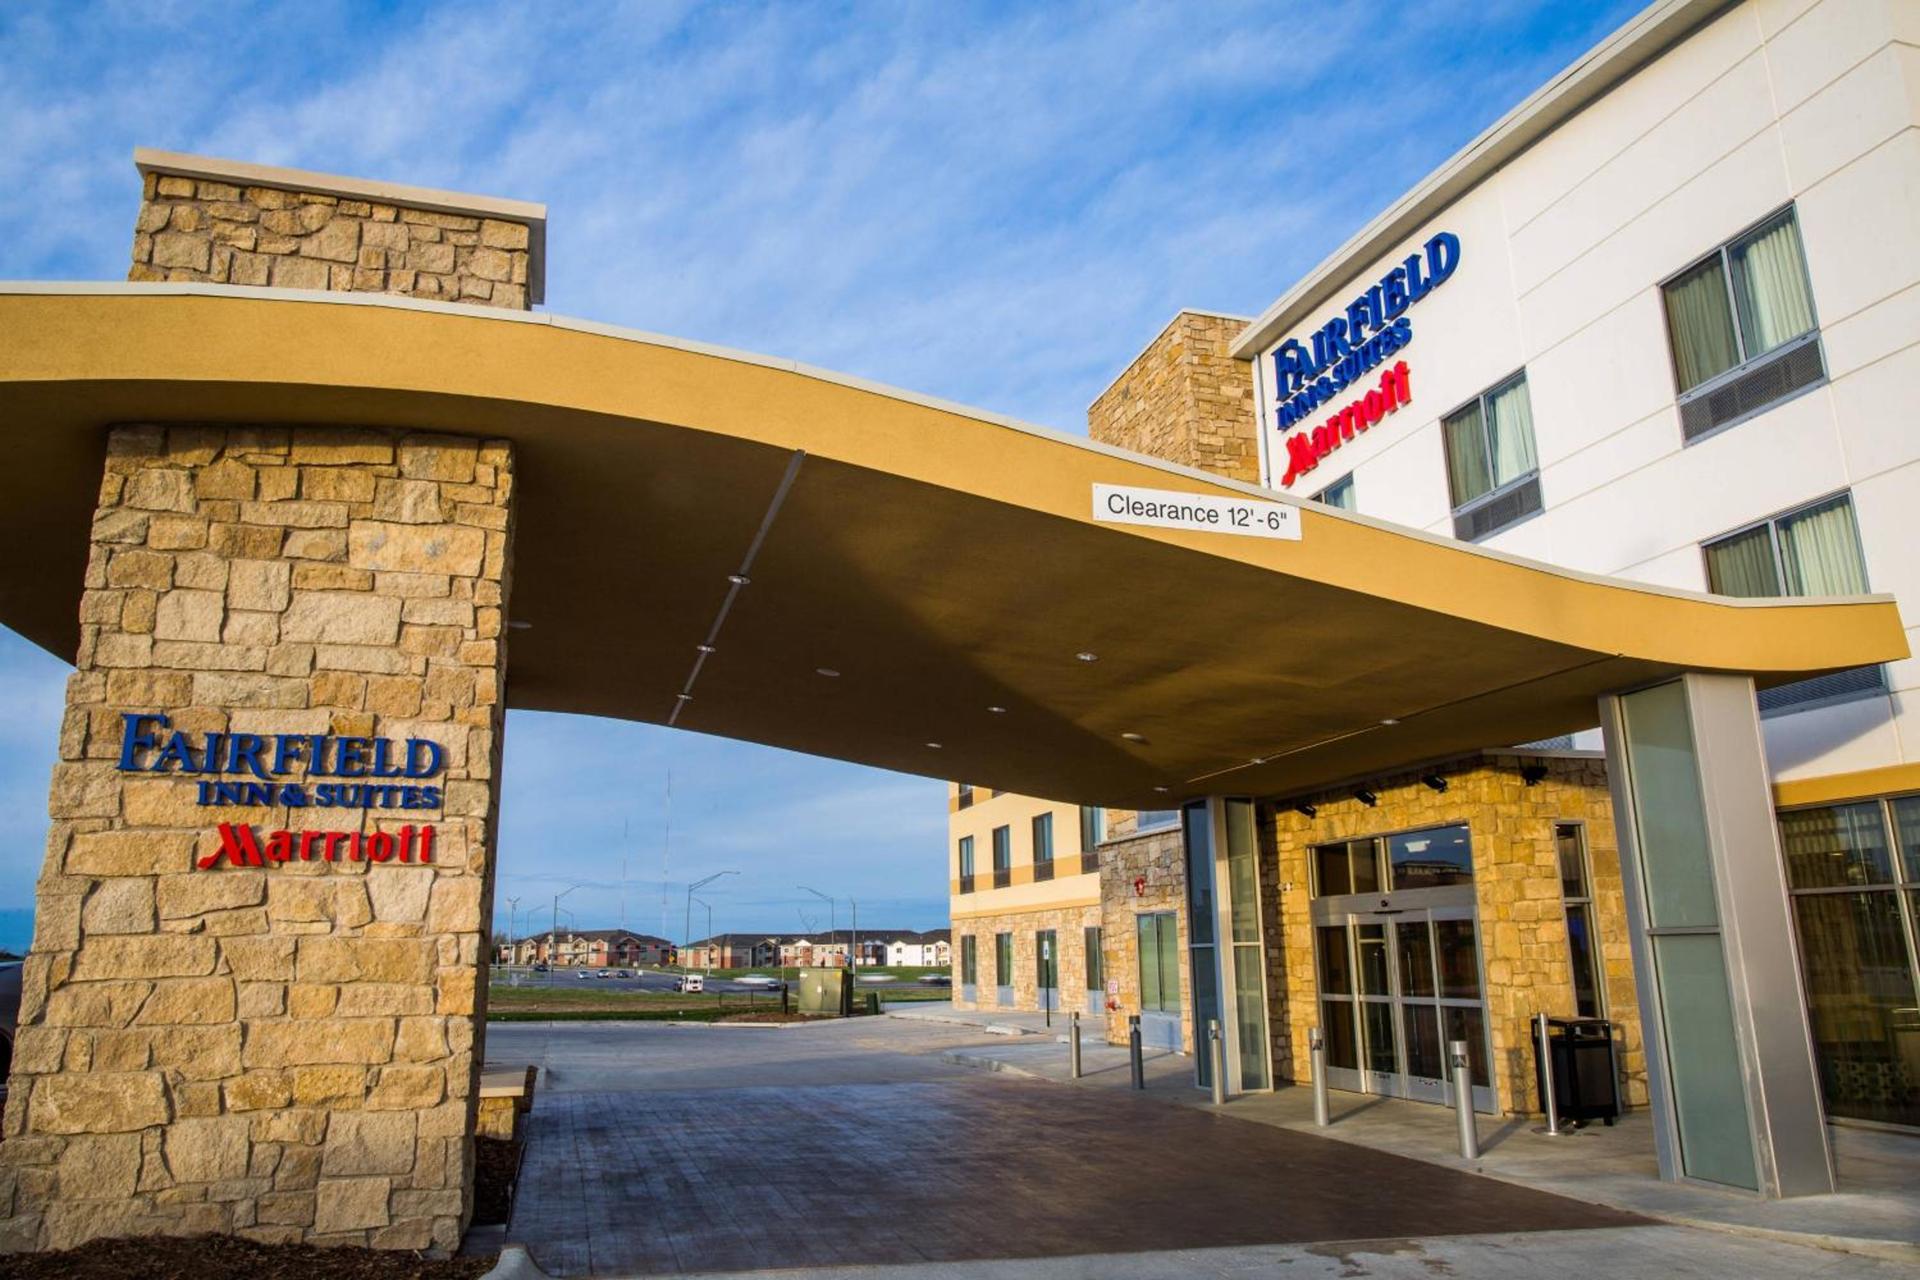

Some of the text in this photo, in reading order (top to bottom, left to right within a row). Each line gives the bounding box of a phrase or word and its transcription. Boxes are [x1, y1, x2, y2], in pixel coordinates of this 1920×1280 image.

[1271, 231, 1461, 401] FAIRFIELD
[1276, 384, 1318, 432] INN
[1332, 317, 1412, 392] SUITES
[1281, 360, 1412, 488] Marriott
[1107, 493, 1288, 530] Clearance 12'-6"
[115, 713, 446, 779] FAIRFIELD
[196, 780, 442, 810] INN & SUITES
[197, 821, 437, 869] Marriott
